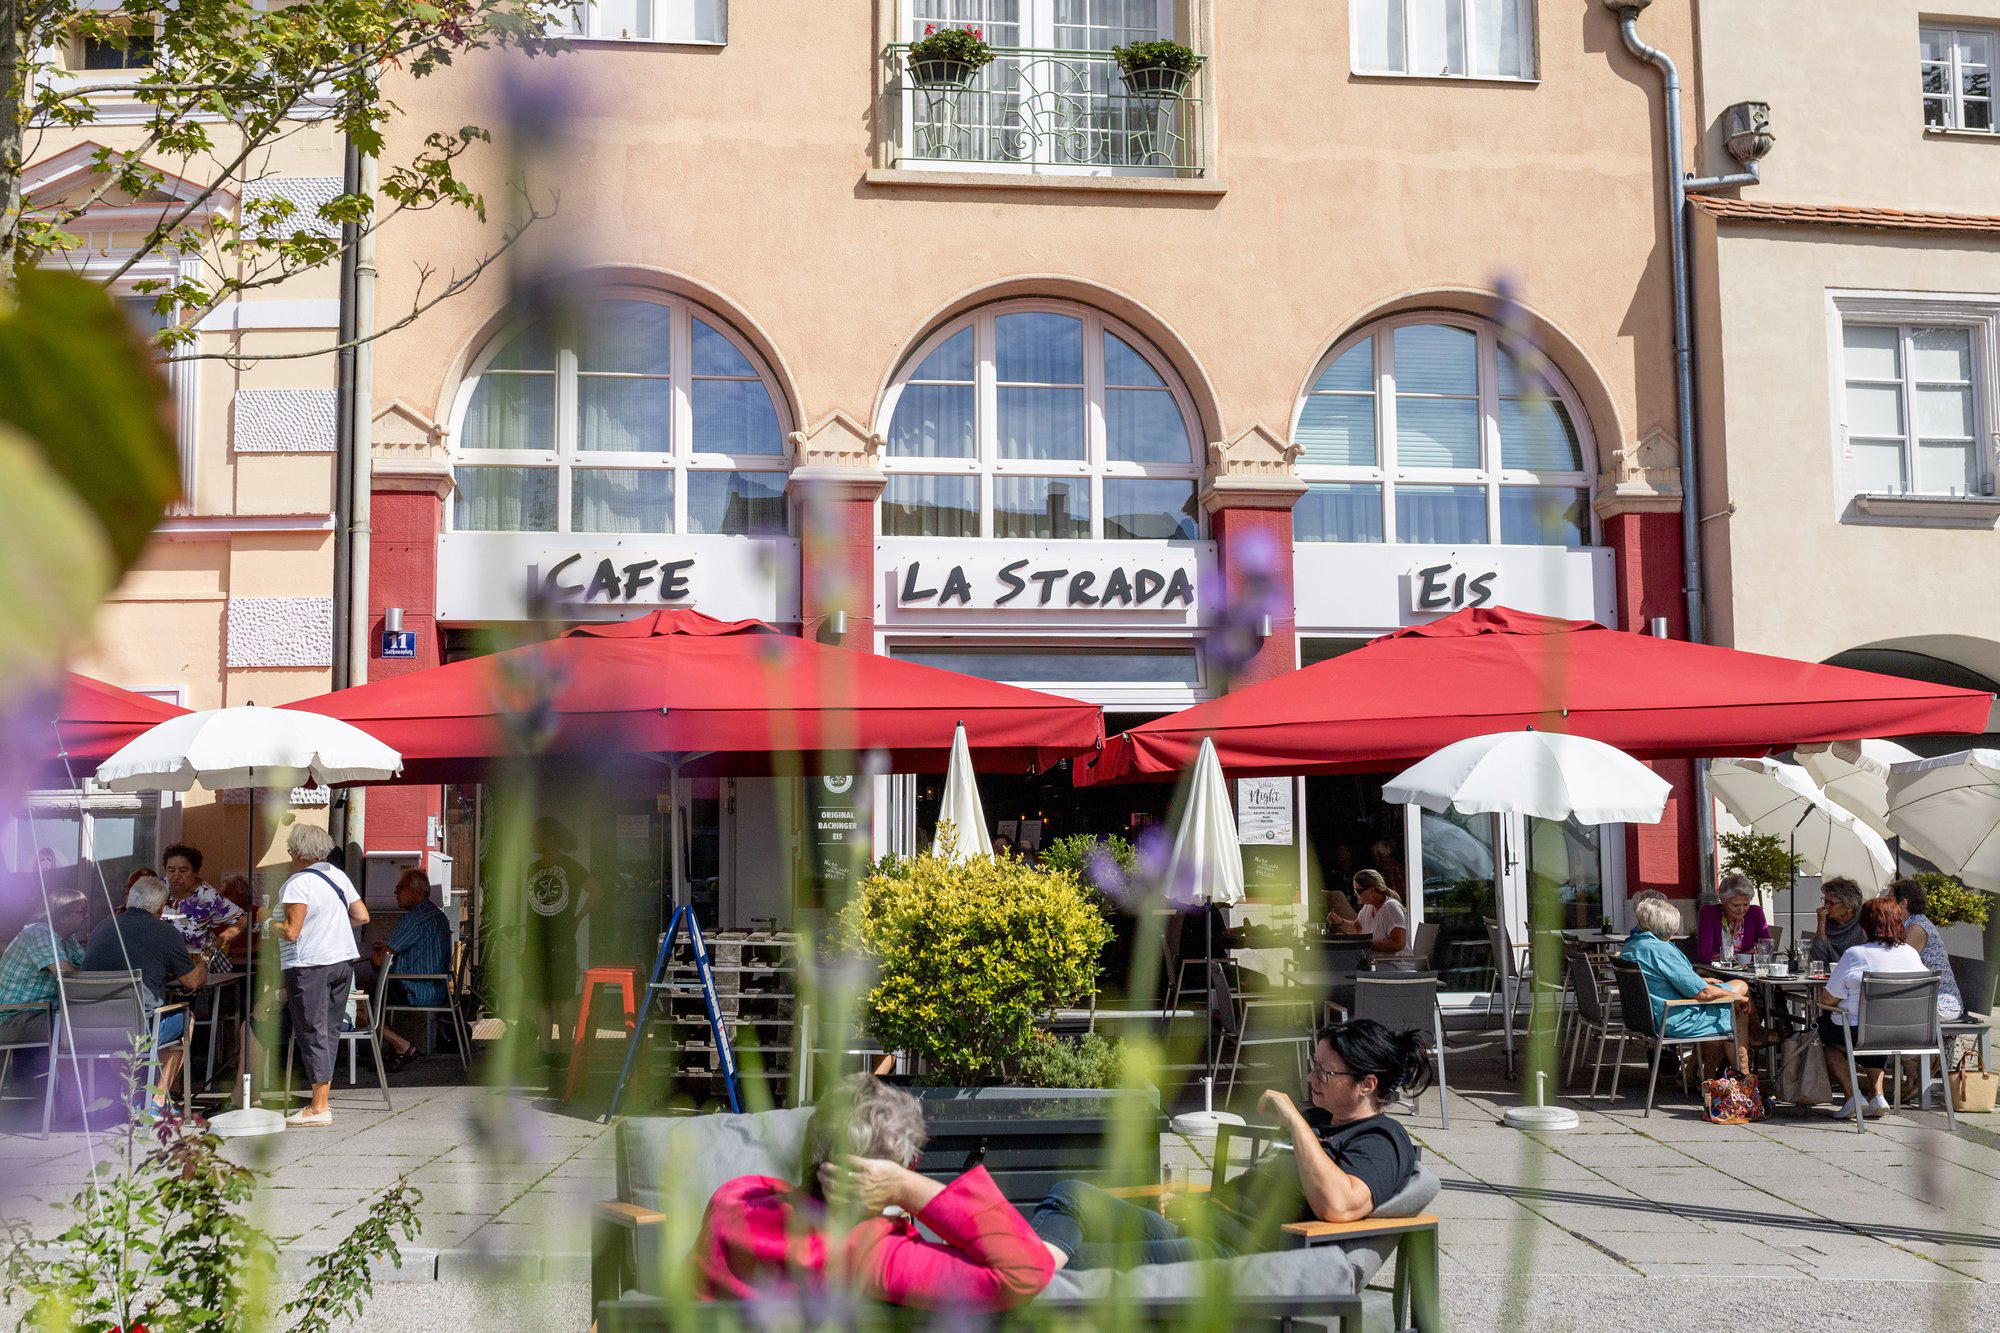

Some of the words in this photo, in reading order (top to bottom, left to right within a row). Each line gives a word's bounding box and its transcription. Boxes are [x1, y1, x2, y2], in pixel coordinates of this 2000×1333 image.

[545, 552, 695, 601] CAFE
[901, 560, 972, 604] LA
[995, 558, 1195, 605] STRADA
[1418, 563, 1498, 608] EIS
[389, 633, 408, 649] 11
[1250, 788, 1280, 805] Night
[821, 811, 854, 819] ORIGINAL
